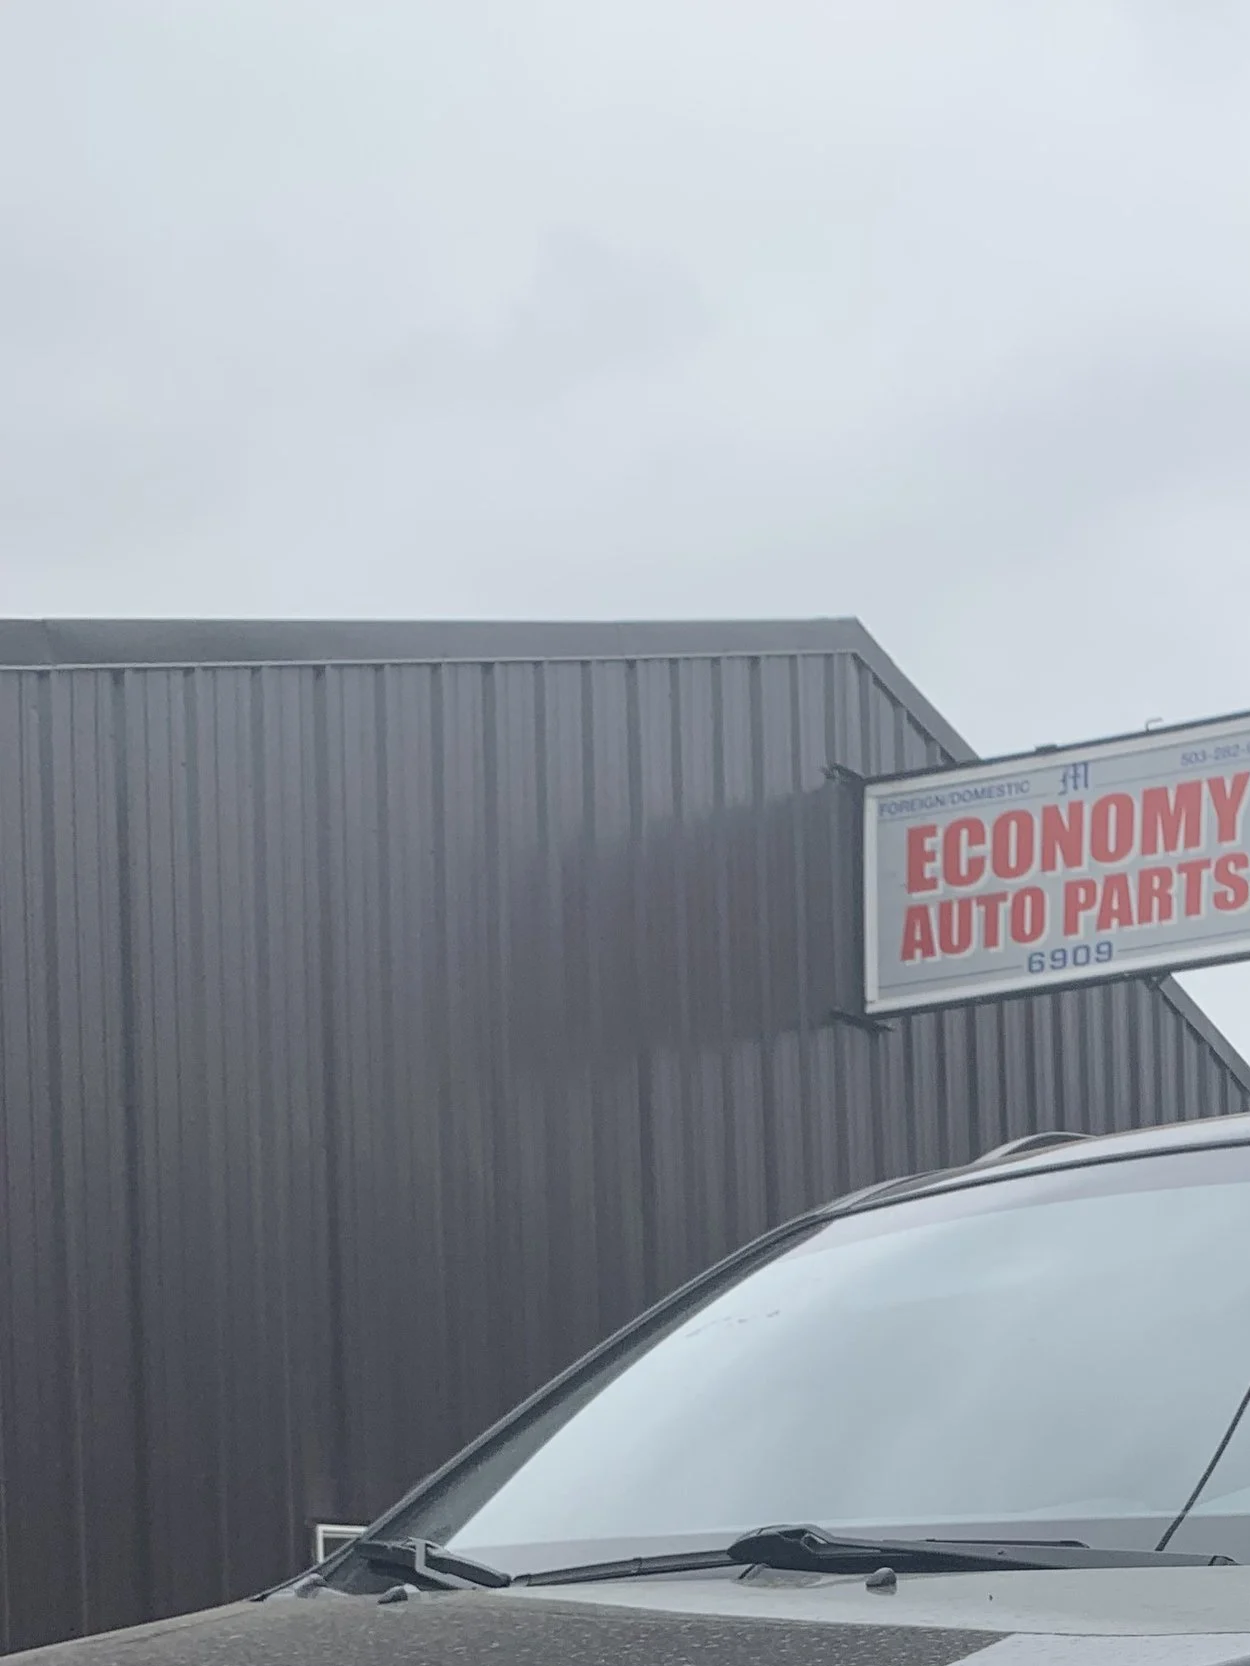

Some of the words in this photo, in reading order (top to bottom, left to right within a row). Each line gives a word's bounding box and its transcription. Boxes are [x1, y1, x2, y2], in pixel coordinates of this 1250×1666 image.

[900, 886, 1046, 962] AUTO
[1063, 852, 1250, 937] PARTS
[1028, 940, 1113, 973] 6909
